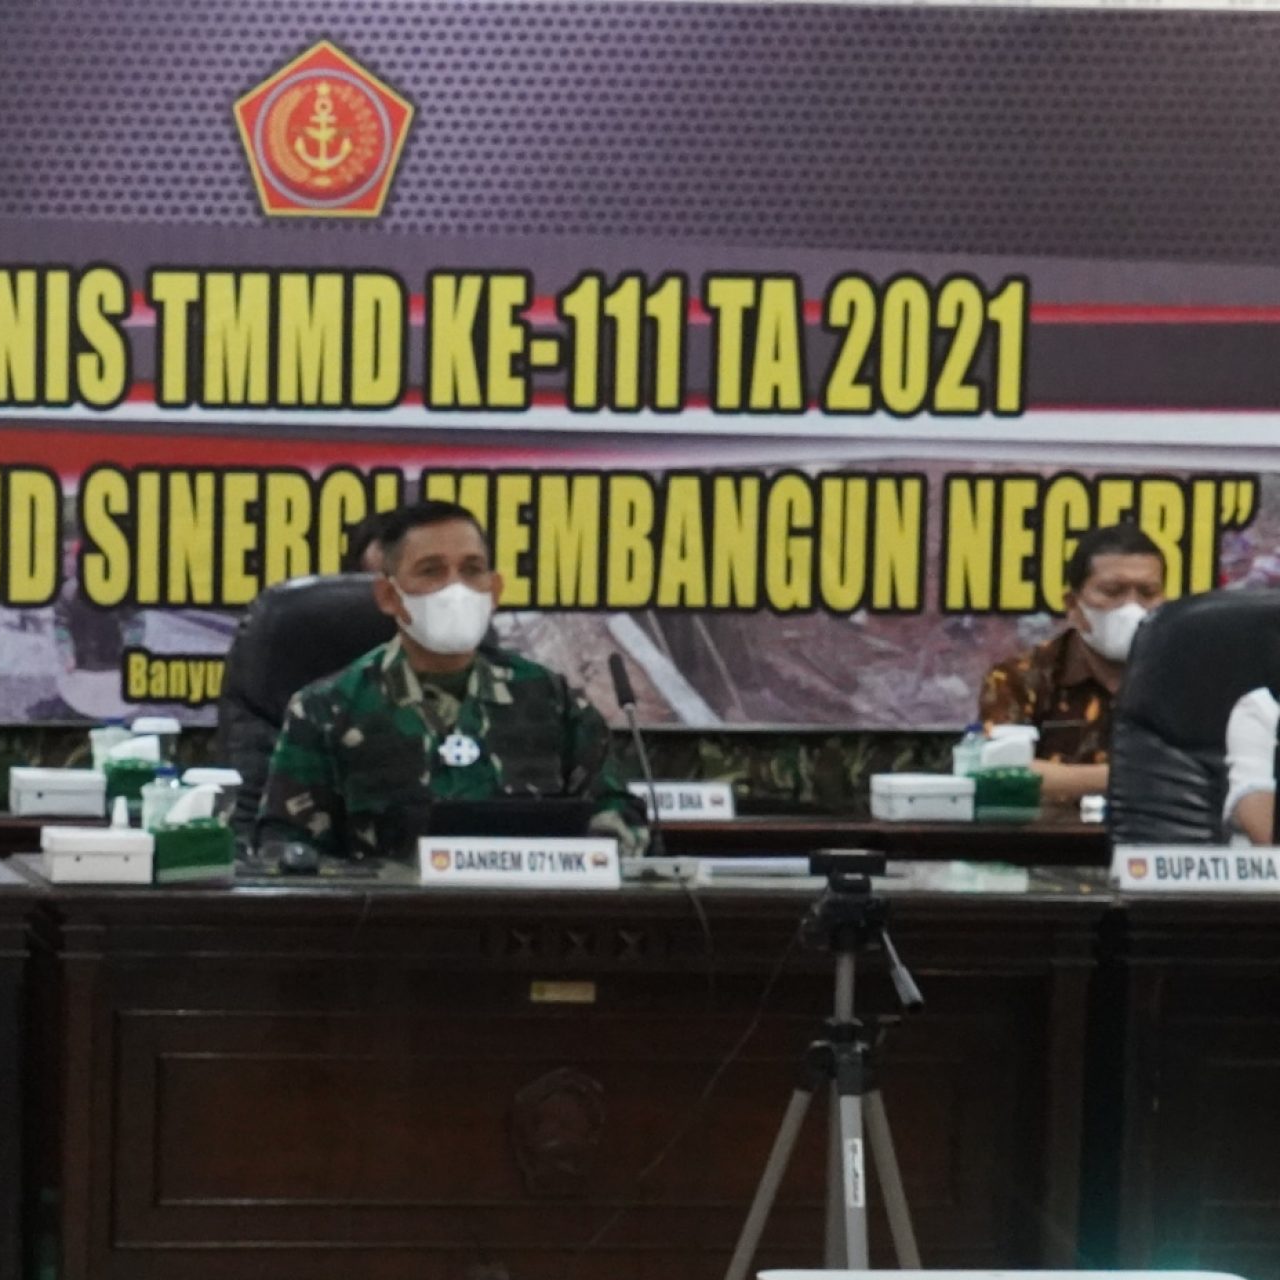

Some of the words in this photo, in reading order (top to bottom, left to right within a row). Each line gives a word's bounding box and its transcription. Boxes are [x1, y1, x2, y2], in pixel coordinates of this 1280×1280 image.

[151, 271, 403, 406] TMMD
[430, 274, 682, 408] KE-111
[707, 277, 802, 410] TA
[826, 277, 1027, 413] 2021
[83, 467, 398, 606] SINERG
[426, 472, 922, 611] EMBANGUN
[454, 850, 523, 873] DANREM
[1155, 857, 1230, 880] BUPATI
[1236, 857, 1278, 880] BNA
